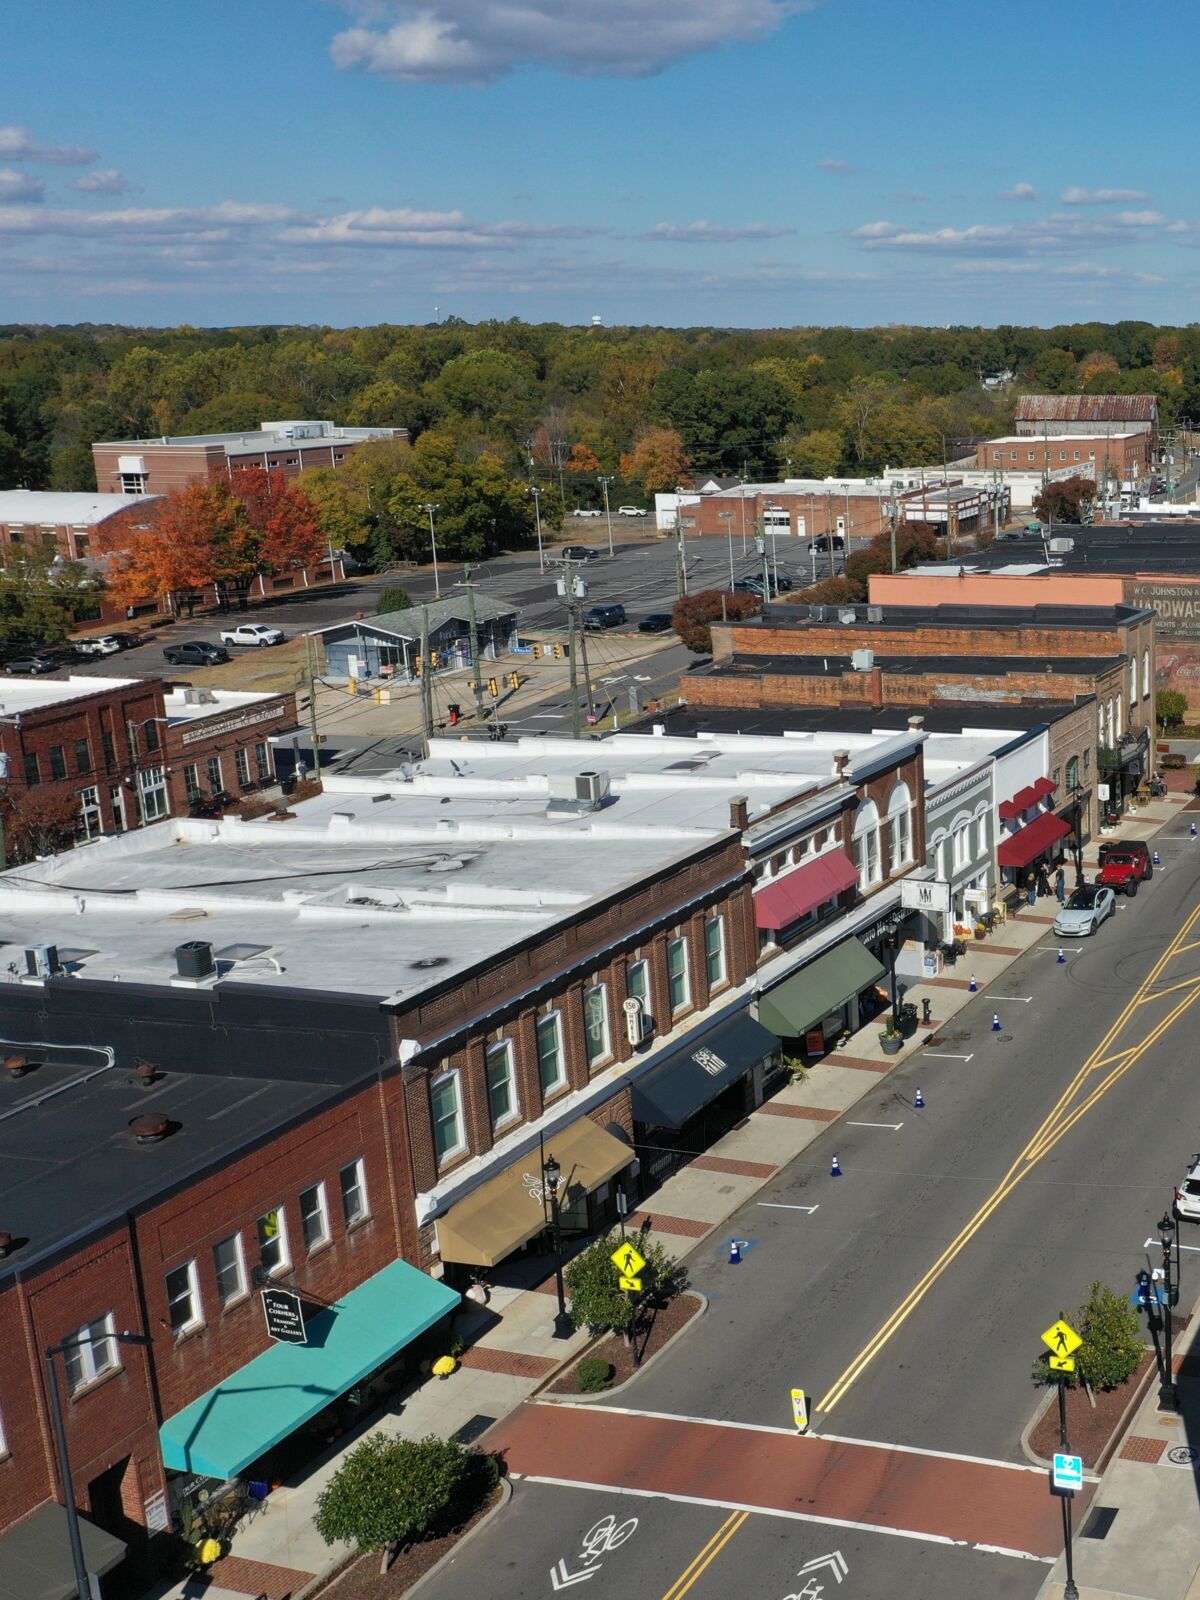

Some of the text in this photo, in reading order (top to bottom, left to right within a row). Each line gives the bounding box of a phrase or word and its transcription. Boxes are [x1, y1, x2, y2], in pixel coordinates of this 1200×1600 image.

[1150, 586, 1193, 597] JOHNSTON
[625, 1001, 637, 1010] 158
[691, 1049, 712, 1069] 158
[703, 1053, 727, 1077] MAIN
[272, 1302, 289, 1310] FOUR
[268, 1308, 296, 1318] CORNERS
[273, 1317, 296, 1326] FRAMING
[280, 1328, 303, 1337] GALLERY
